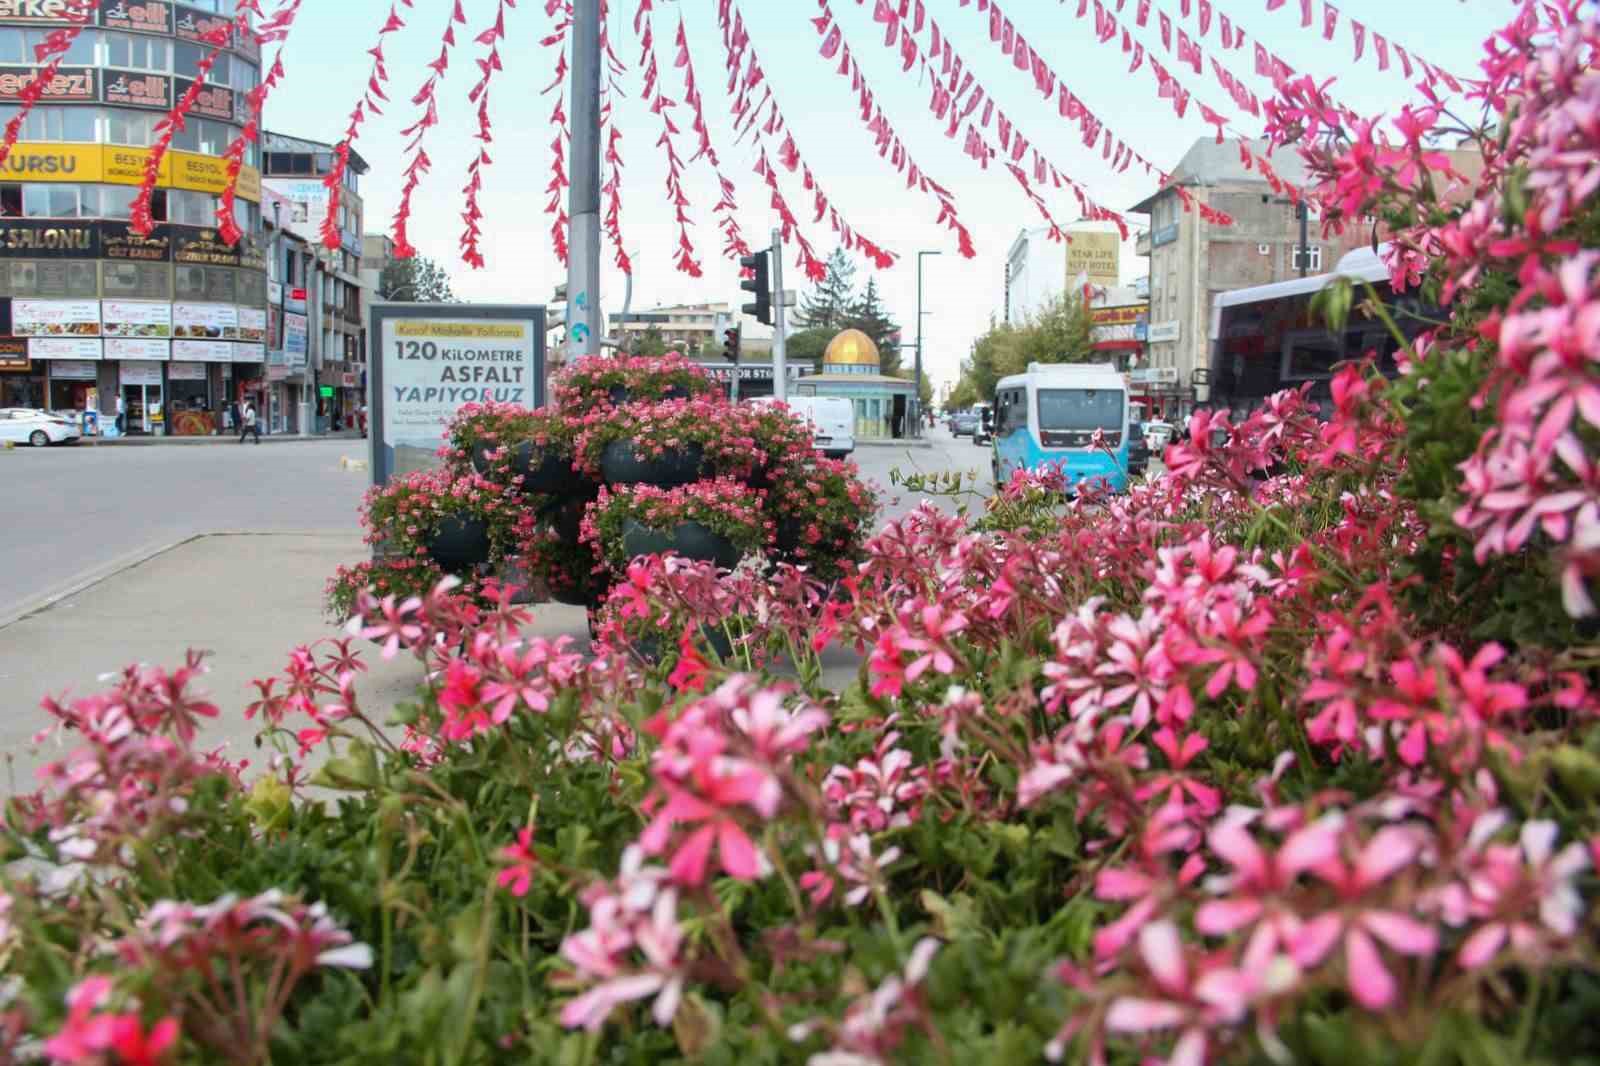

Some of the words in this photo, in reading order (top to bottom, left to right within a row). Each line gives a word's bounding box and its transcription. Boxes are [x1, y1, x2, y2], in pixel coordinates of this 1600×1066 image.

[8, 228, 91, 249] SALONU
[394, 341, 437, 360] 120
[440, 366, 524, 383] ASFALT
